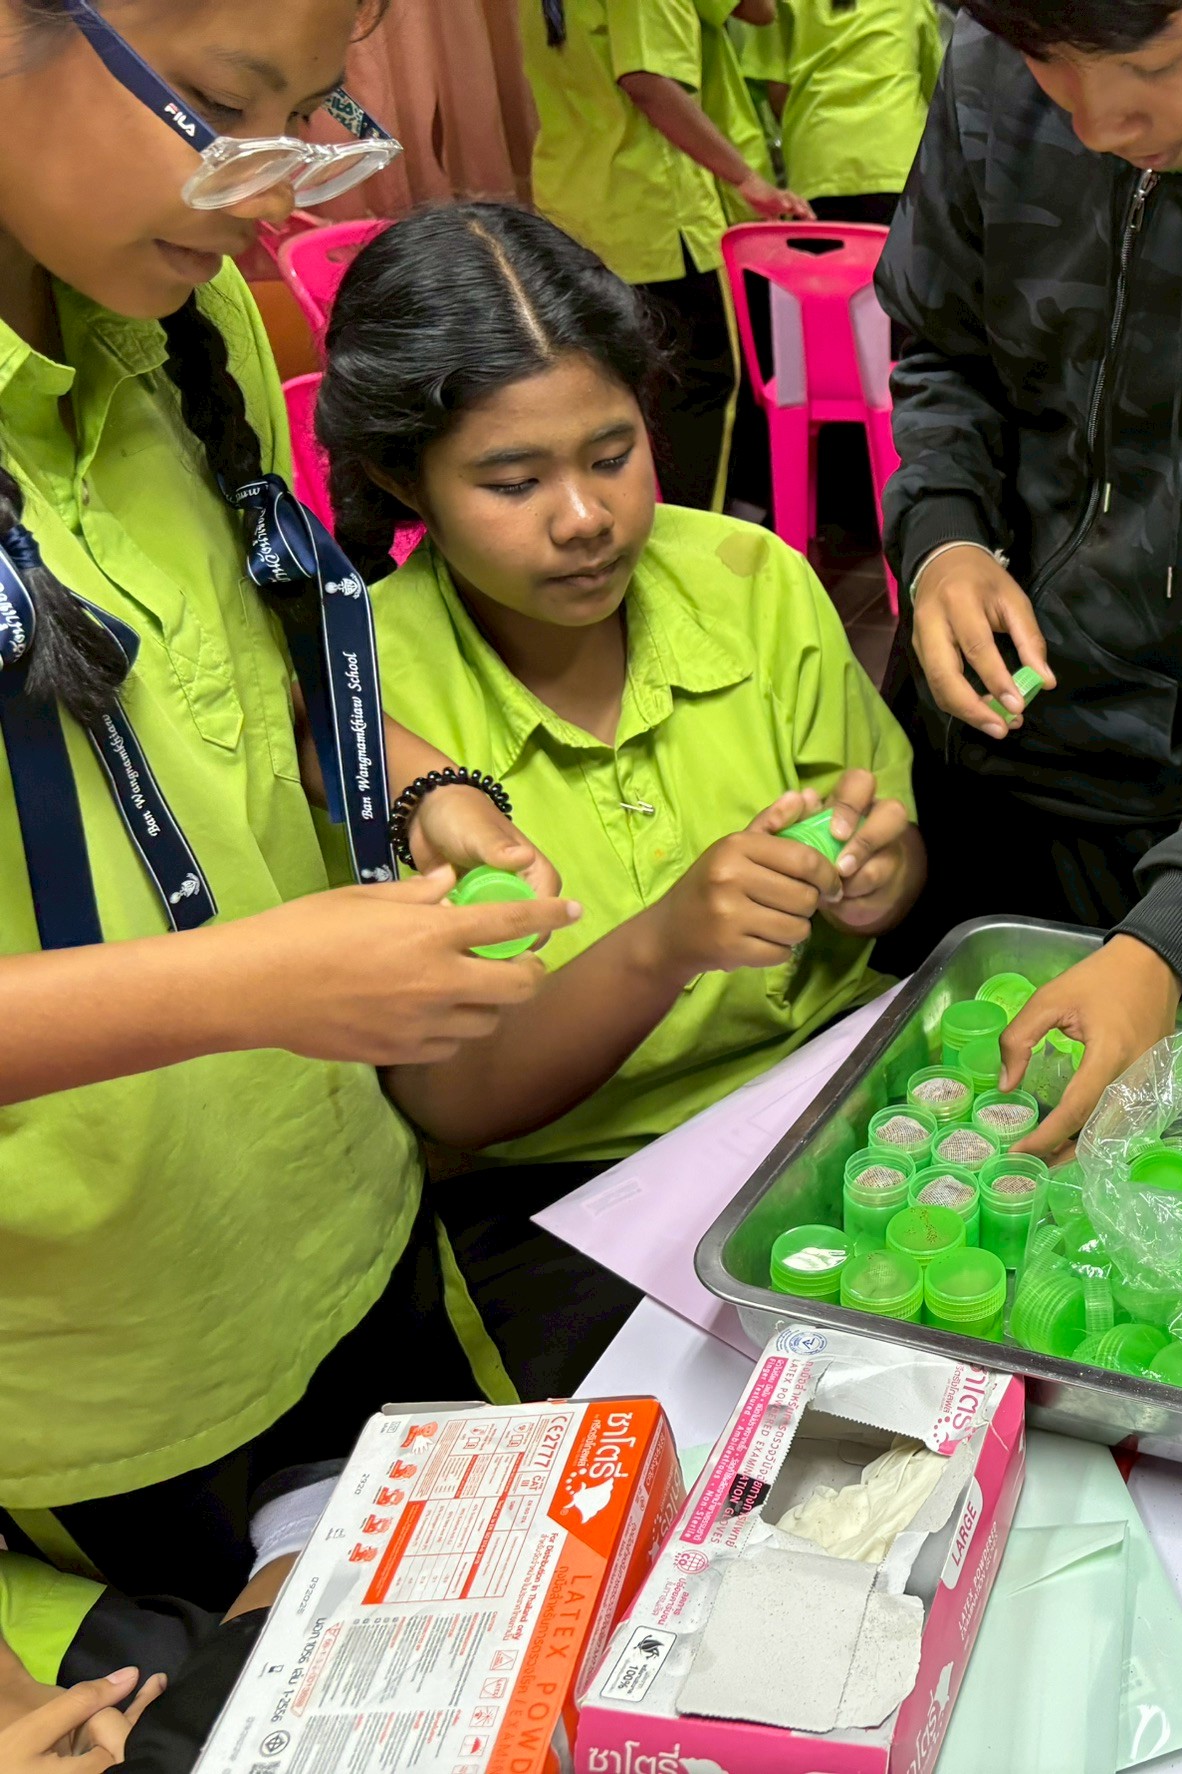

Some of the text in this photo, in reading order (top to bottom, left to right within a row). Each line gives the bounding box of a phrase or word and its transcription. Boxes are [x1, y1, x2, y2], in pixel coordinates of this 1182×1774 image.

[164, 103, 195, 137] FILA
[343, 651, 361, 691] School
[142, 809, 160, 836] Ban
[361, 796, 373, 819] Ban
[684, 1358, 775, 1538] Finger Textured Ambidextrous Non-Sterile
[709, 1358, 799, 1544] LATEX POWDERED EXAMINATION GLOVES
[528, 1475, 541, 1491] CAT
[548, 1533, 558, 1543] For
[949, 1501, 978, 1566] LARGE
[520, 1594, 536, 1622] Thailand
[546, 1575, 591, 1659] LATEX
[618, 1665, 638, 1689] 100%
